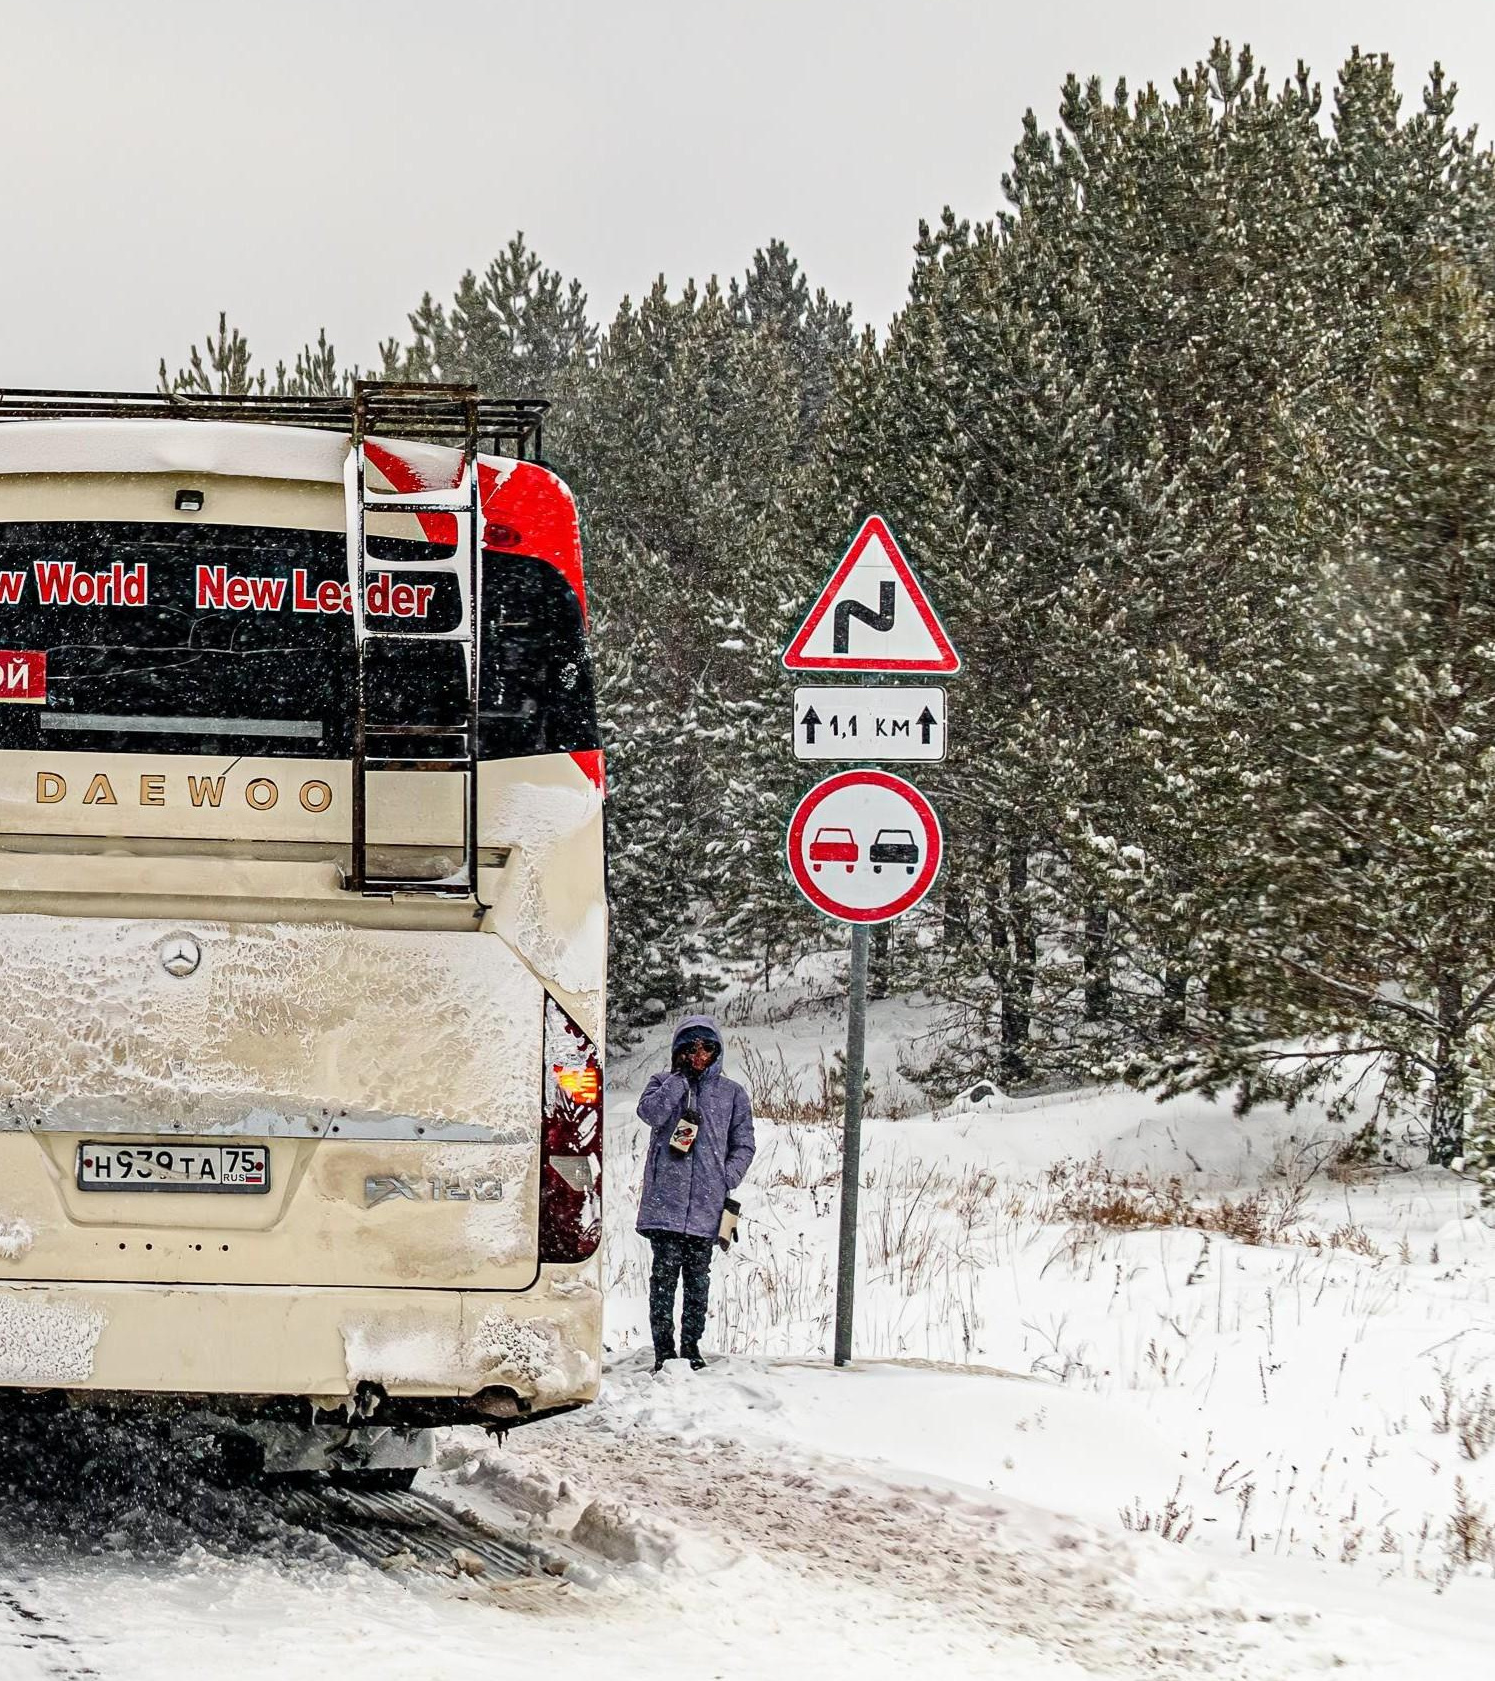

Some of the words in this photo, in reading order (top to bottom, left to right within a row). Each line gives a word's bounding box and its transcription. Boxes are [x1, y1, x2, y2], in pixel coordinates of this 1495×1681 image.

[34, 561, 148, 606] World
[196, 565, 287, 611] New
[829, 714, 858, 739] 1,1
[36, 771, 333, 813] DAEWOO
[225, 1150, 255, 1173] 75
[223, 1173, 245, 1182] RUS
